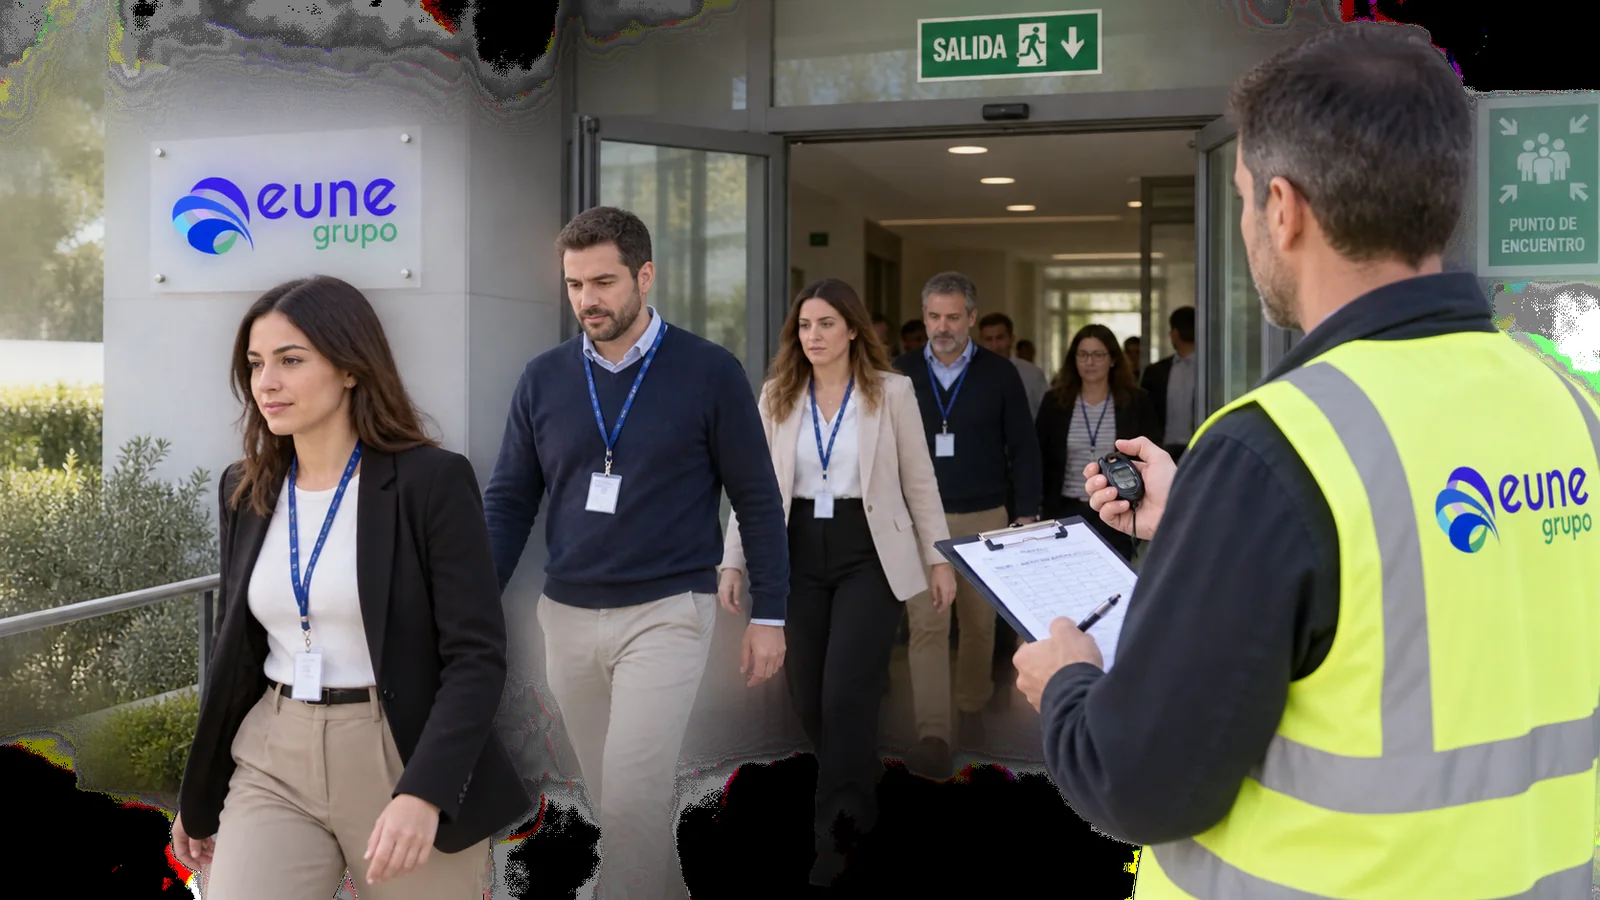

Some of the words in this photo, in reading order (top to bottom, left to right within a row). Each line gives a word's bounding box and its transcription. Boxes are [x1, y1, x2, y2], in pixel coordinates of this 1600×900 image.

[933, 34, 1008, 63] SALIDA
[257, 177, 397, 219] eune
[313, 222, 398, 250] grupo
[1509, 217, 1556, 232] PUNTO
[1559, 216, 1577, 231] DE
[1501, 237, 1585, 253] ENCUENTRO
[1498, 467, 1589, 514] eune
[1542, 513, 1592, 545] grupo
